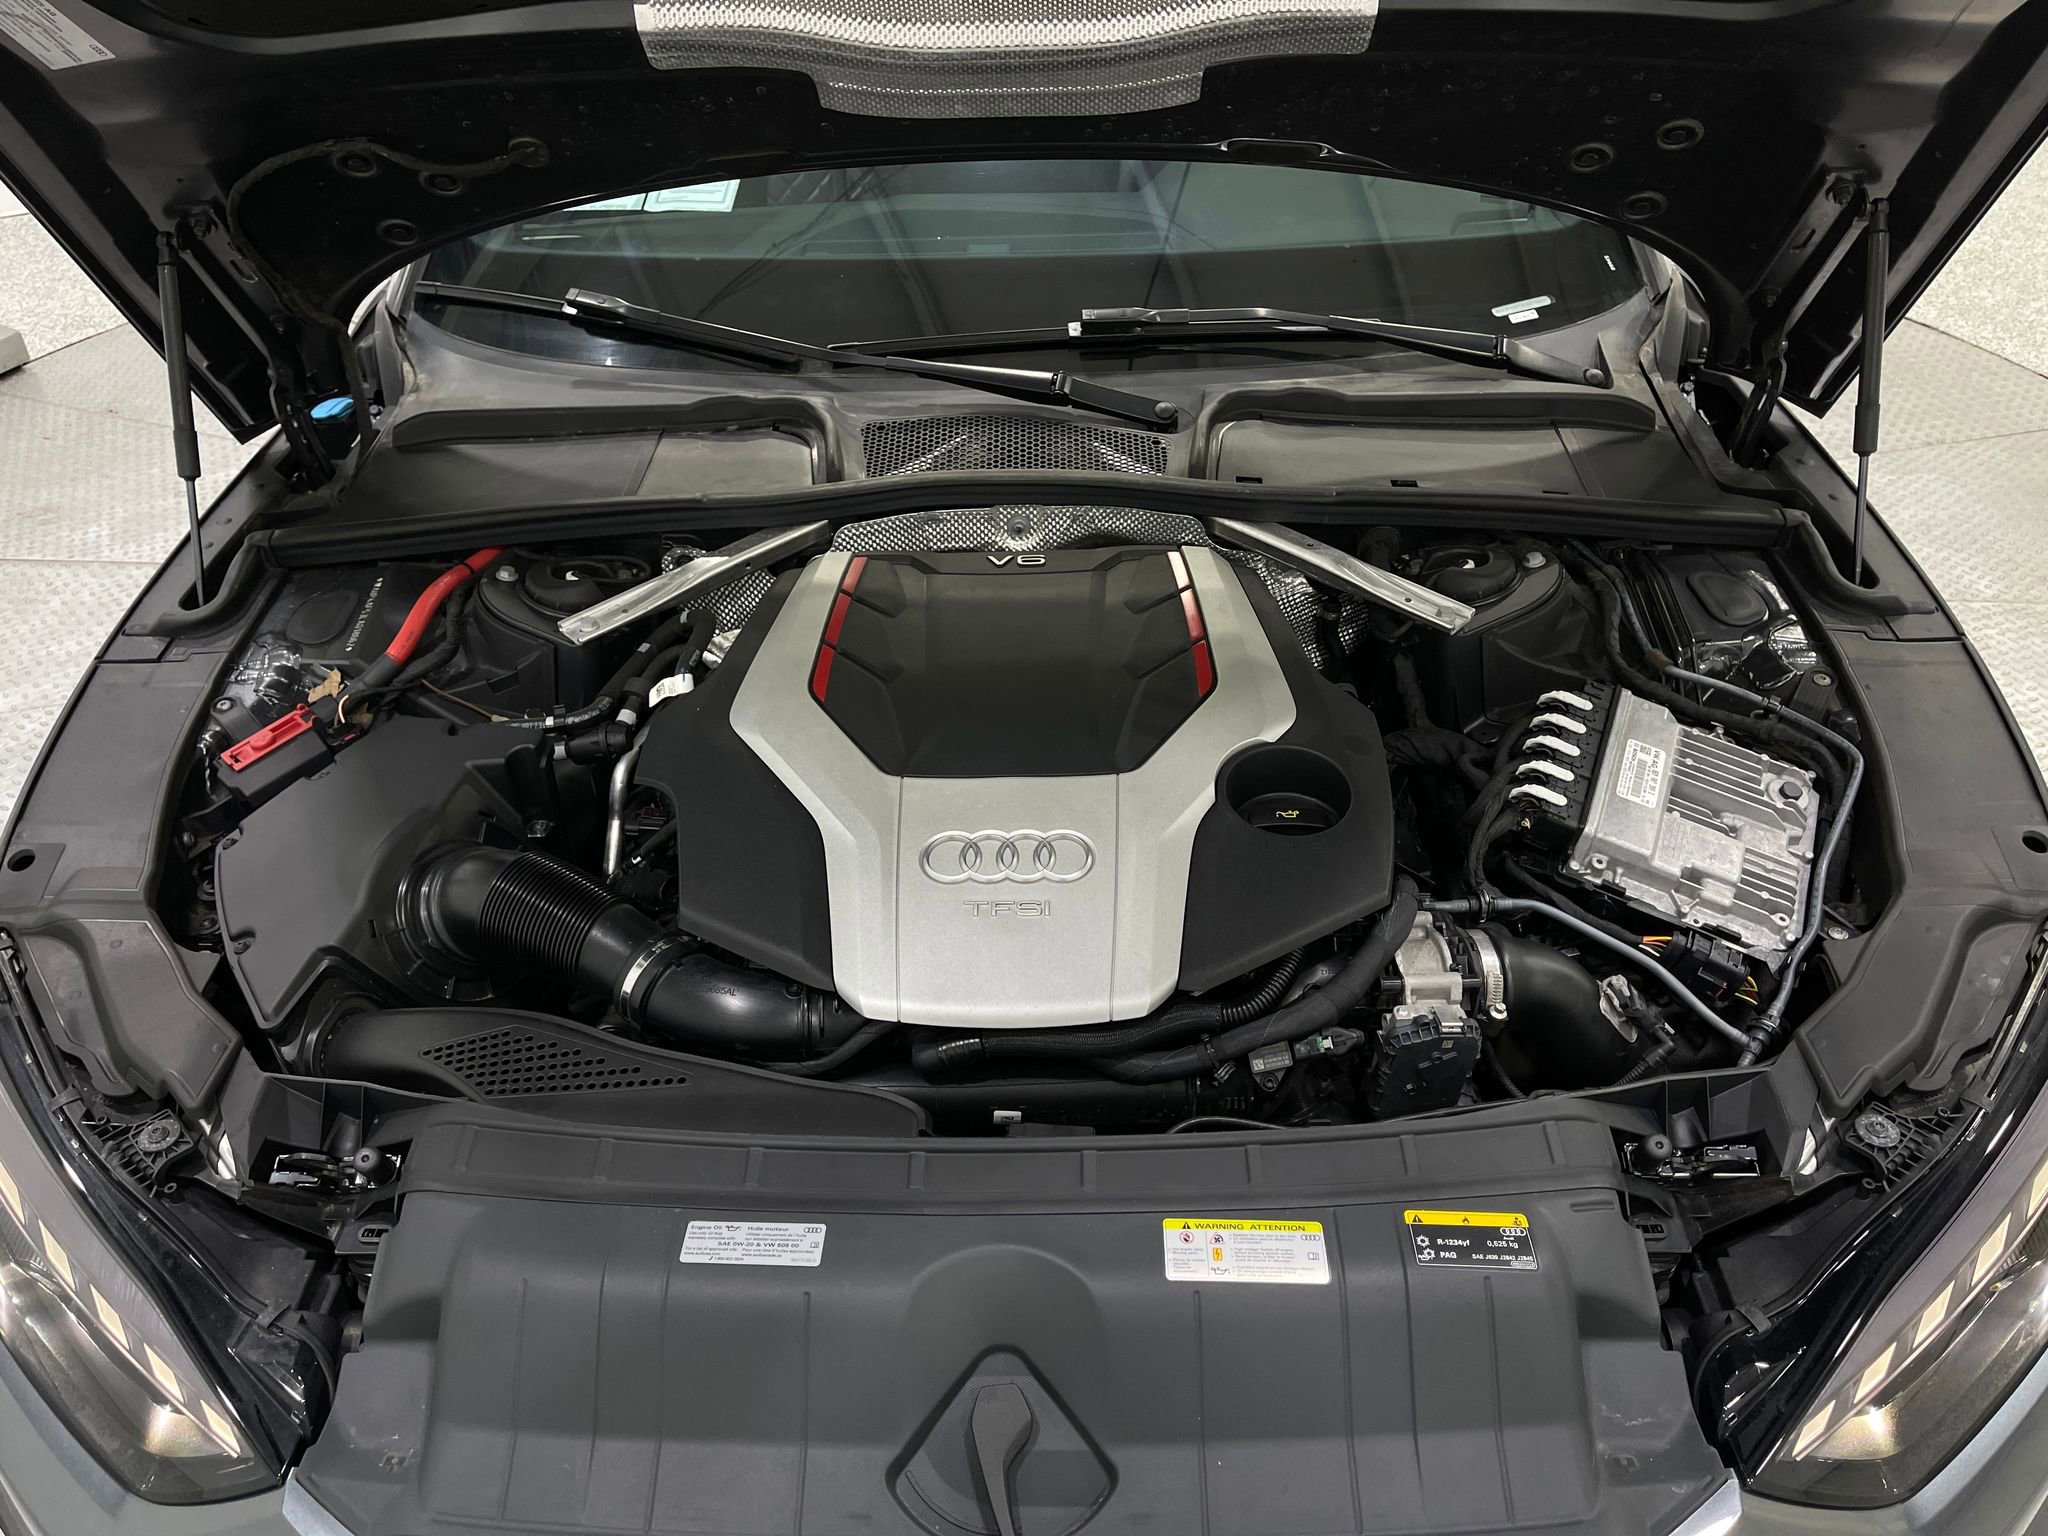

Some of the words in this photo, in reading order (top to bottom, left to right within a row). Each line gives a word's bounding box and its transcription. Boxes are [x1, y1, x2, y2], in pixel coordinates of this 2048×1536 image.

[987, 554, 1046, 567] V6
[1651, 759, 1659, 769] AG
[963, 900, 1050, 917] TFSI
[1250, 1223, 1306, 1232] ATTENTION
[1437, 1238, 1470, 1247] R-1234yf
[1508, 1240, 1519, 1249] kg
[1440, 1251, 1457, 1259] PAG
